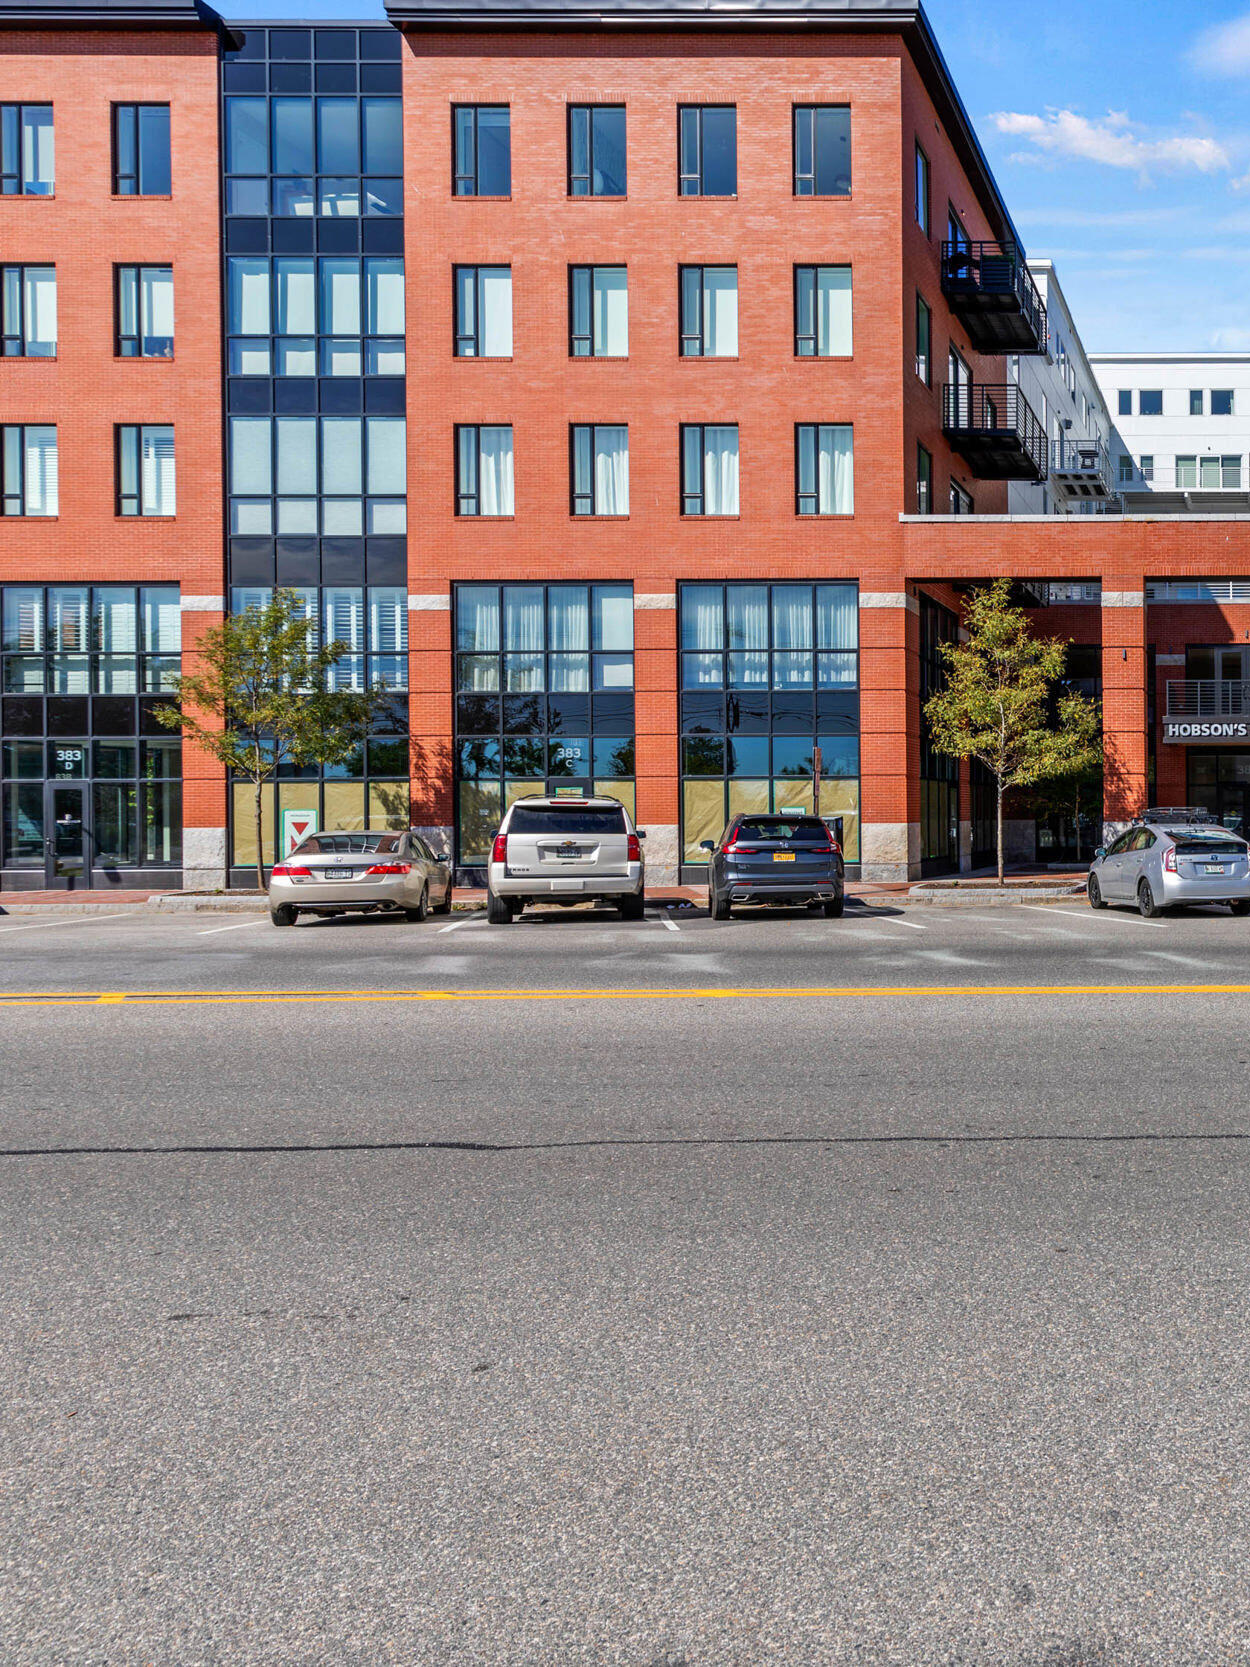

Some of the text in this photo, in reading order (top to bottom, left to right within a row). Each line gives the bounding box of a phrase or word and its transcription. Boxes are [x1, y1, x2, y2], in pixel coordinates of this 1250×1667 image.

[1168, 723, 1247, 736] HOBSON'S
[56, 750, 81, 761] 383
[557, 747, 581, 758] 383
[65, 762, 73, 770] D
[565, 759, 573, 768] C
